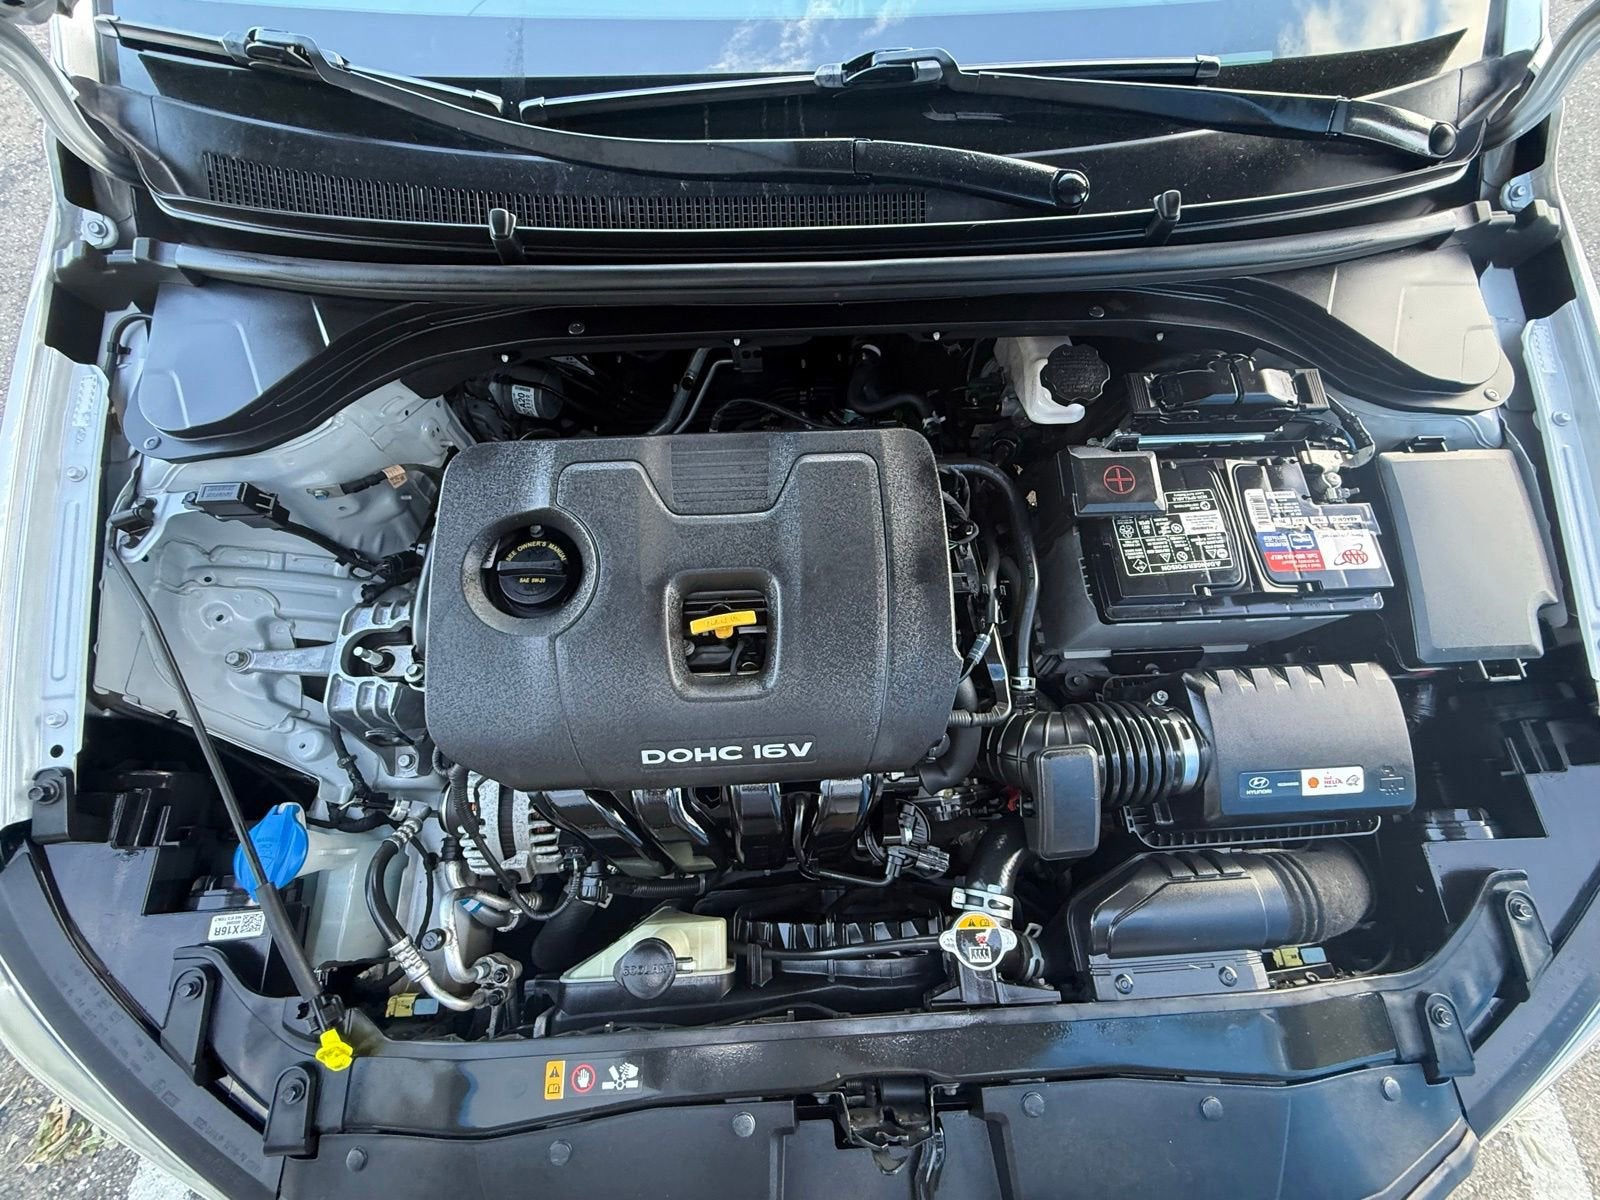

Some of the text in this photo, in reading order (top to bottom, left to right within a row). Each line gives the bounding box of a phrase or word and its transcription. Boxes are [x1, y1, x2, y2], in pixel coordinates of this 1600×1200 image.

[505, 550, 518, 562] SEE
[516, 540, 548, 552] OWNER'S
[641, 742, 813, 765] DOHC 16V
[214, 925, 240, 936] X16R
